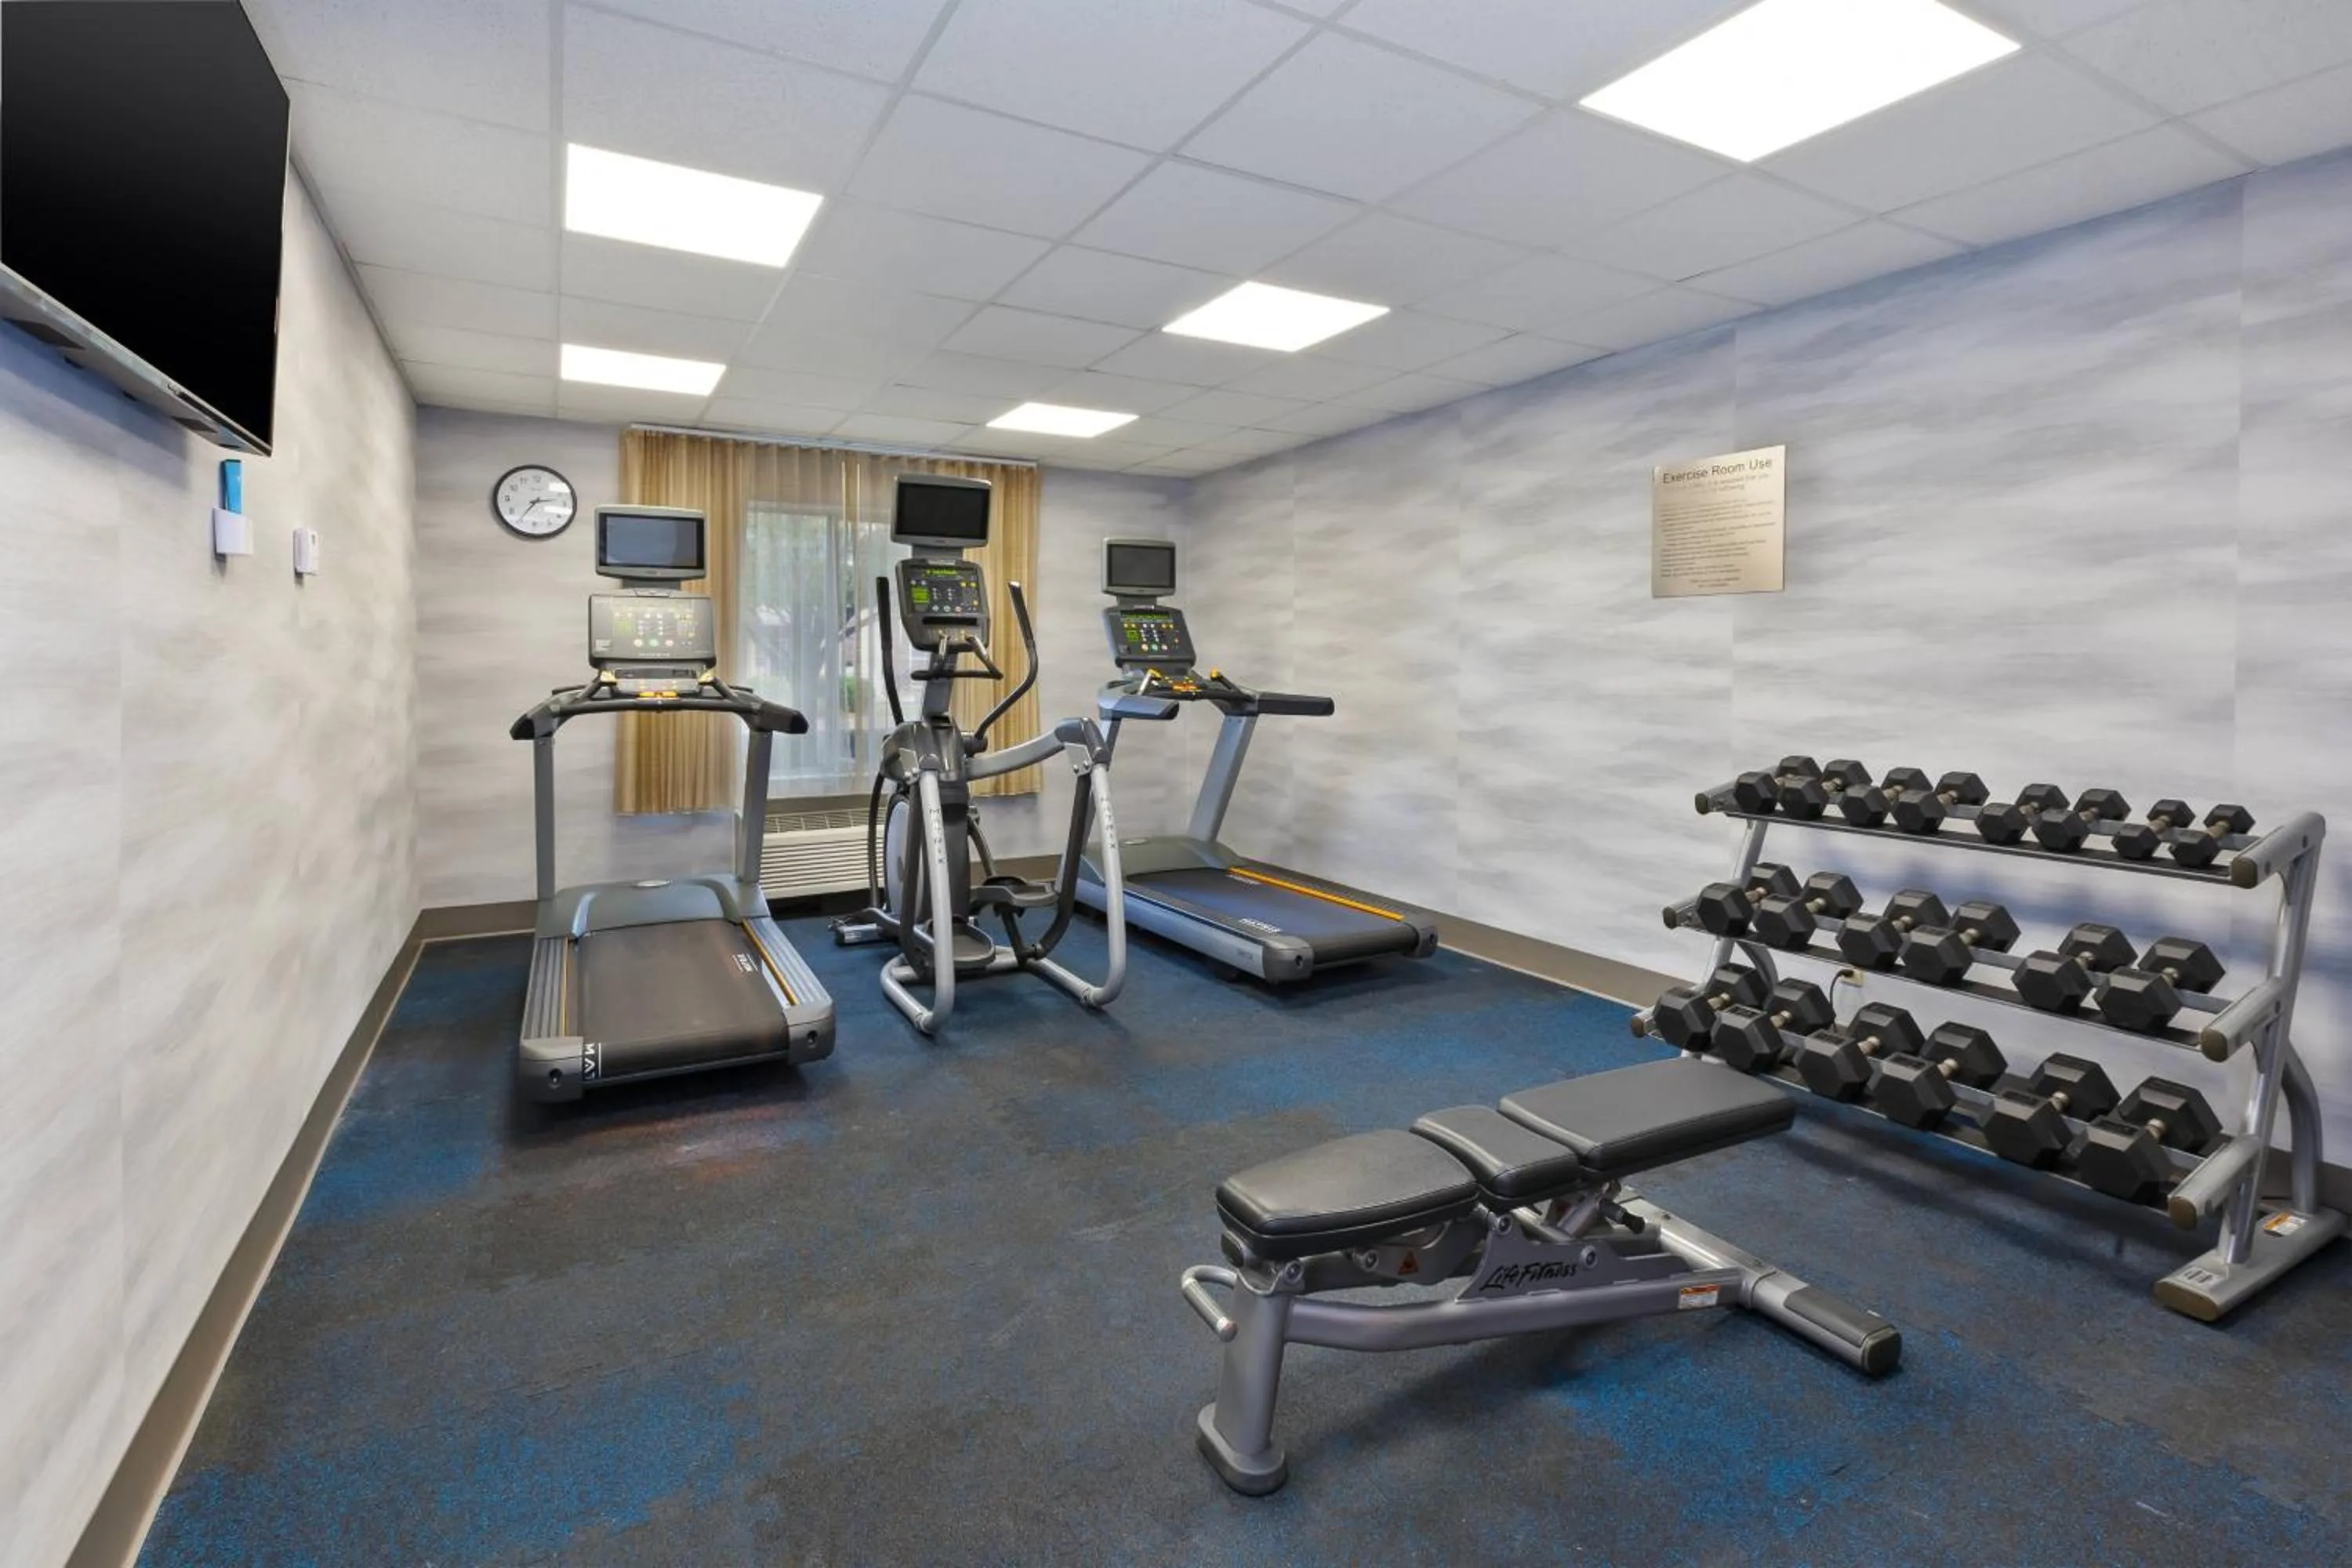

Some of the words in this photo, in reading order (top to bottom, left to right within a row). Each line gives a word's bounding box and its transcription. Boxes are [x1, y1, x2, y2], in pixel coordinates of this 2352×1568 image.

[1663, 469, 1708, 484] Exercise
[1711, 463, 1745, 476] Room
[1749, 458, 1773, 470] Use
